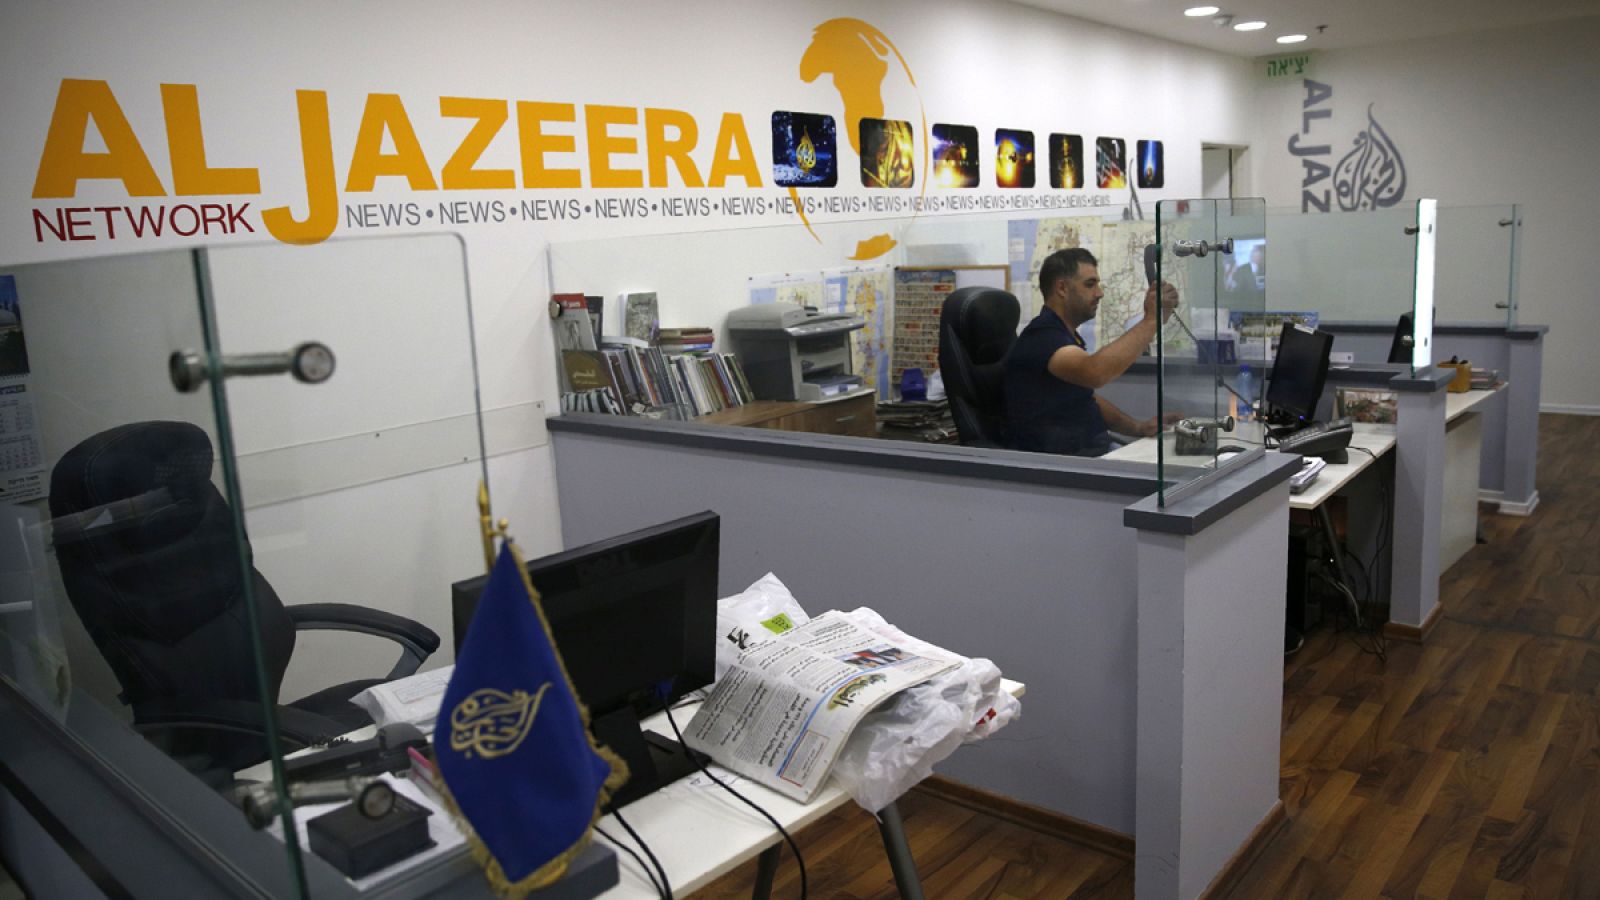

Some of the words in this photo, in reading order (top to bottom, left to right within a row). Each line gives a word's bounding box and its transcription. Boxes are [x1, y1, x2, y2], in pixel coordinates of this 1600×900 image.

[1267, 56, 1309, 77] יציאה
[1303, 78, 1332, 134] AL
[32, 78, 261, 199] AL
[261, 89, 764, 245] JAZEERA
[31, 203, 255, 242] NETWORK
[346, 203, 421, 228] NEWS
[439, 200, 506, 225] NEWS
[521, 199, 581, 221] NEWS
[595, 198, 649, 218] NEWS
[661, 197, 710, 217] NEWS
[722, 197, 766, 216] NEWS
[776, 196, 816, 214] NEWS
[824, 196, 860, 213] NEWS
[868, 196, 901, 212] NEWS
[909, 196, 940, 211] NEWS
[946, 195, 974, 210] NEWS
[980, 195, 1005, 209] NEWS
[1011, 195, 1035, 208] NEWS
